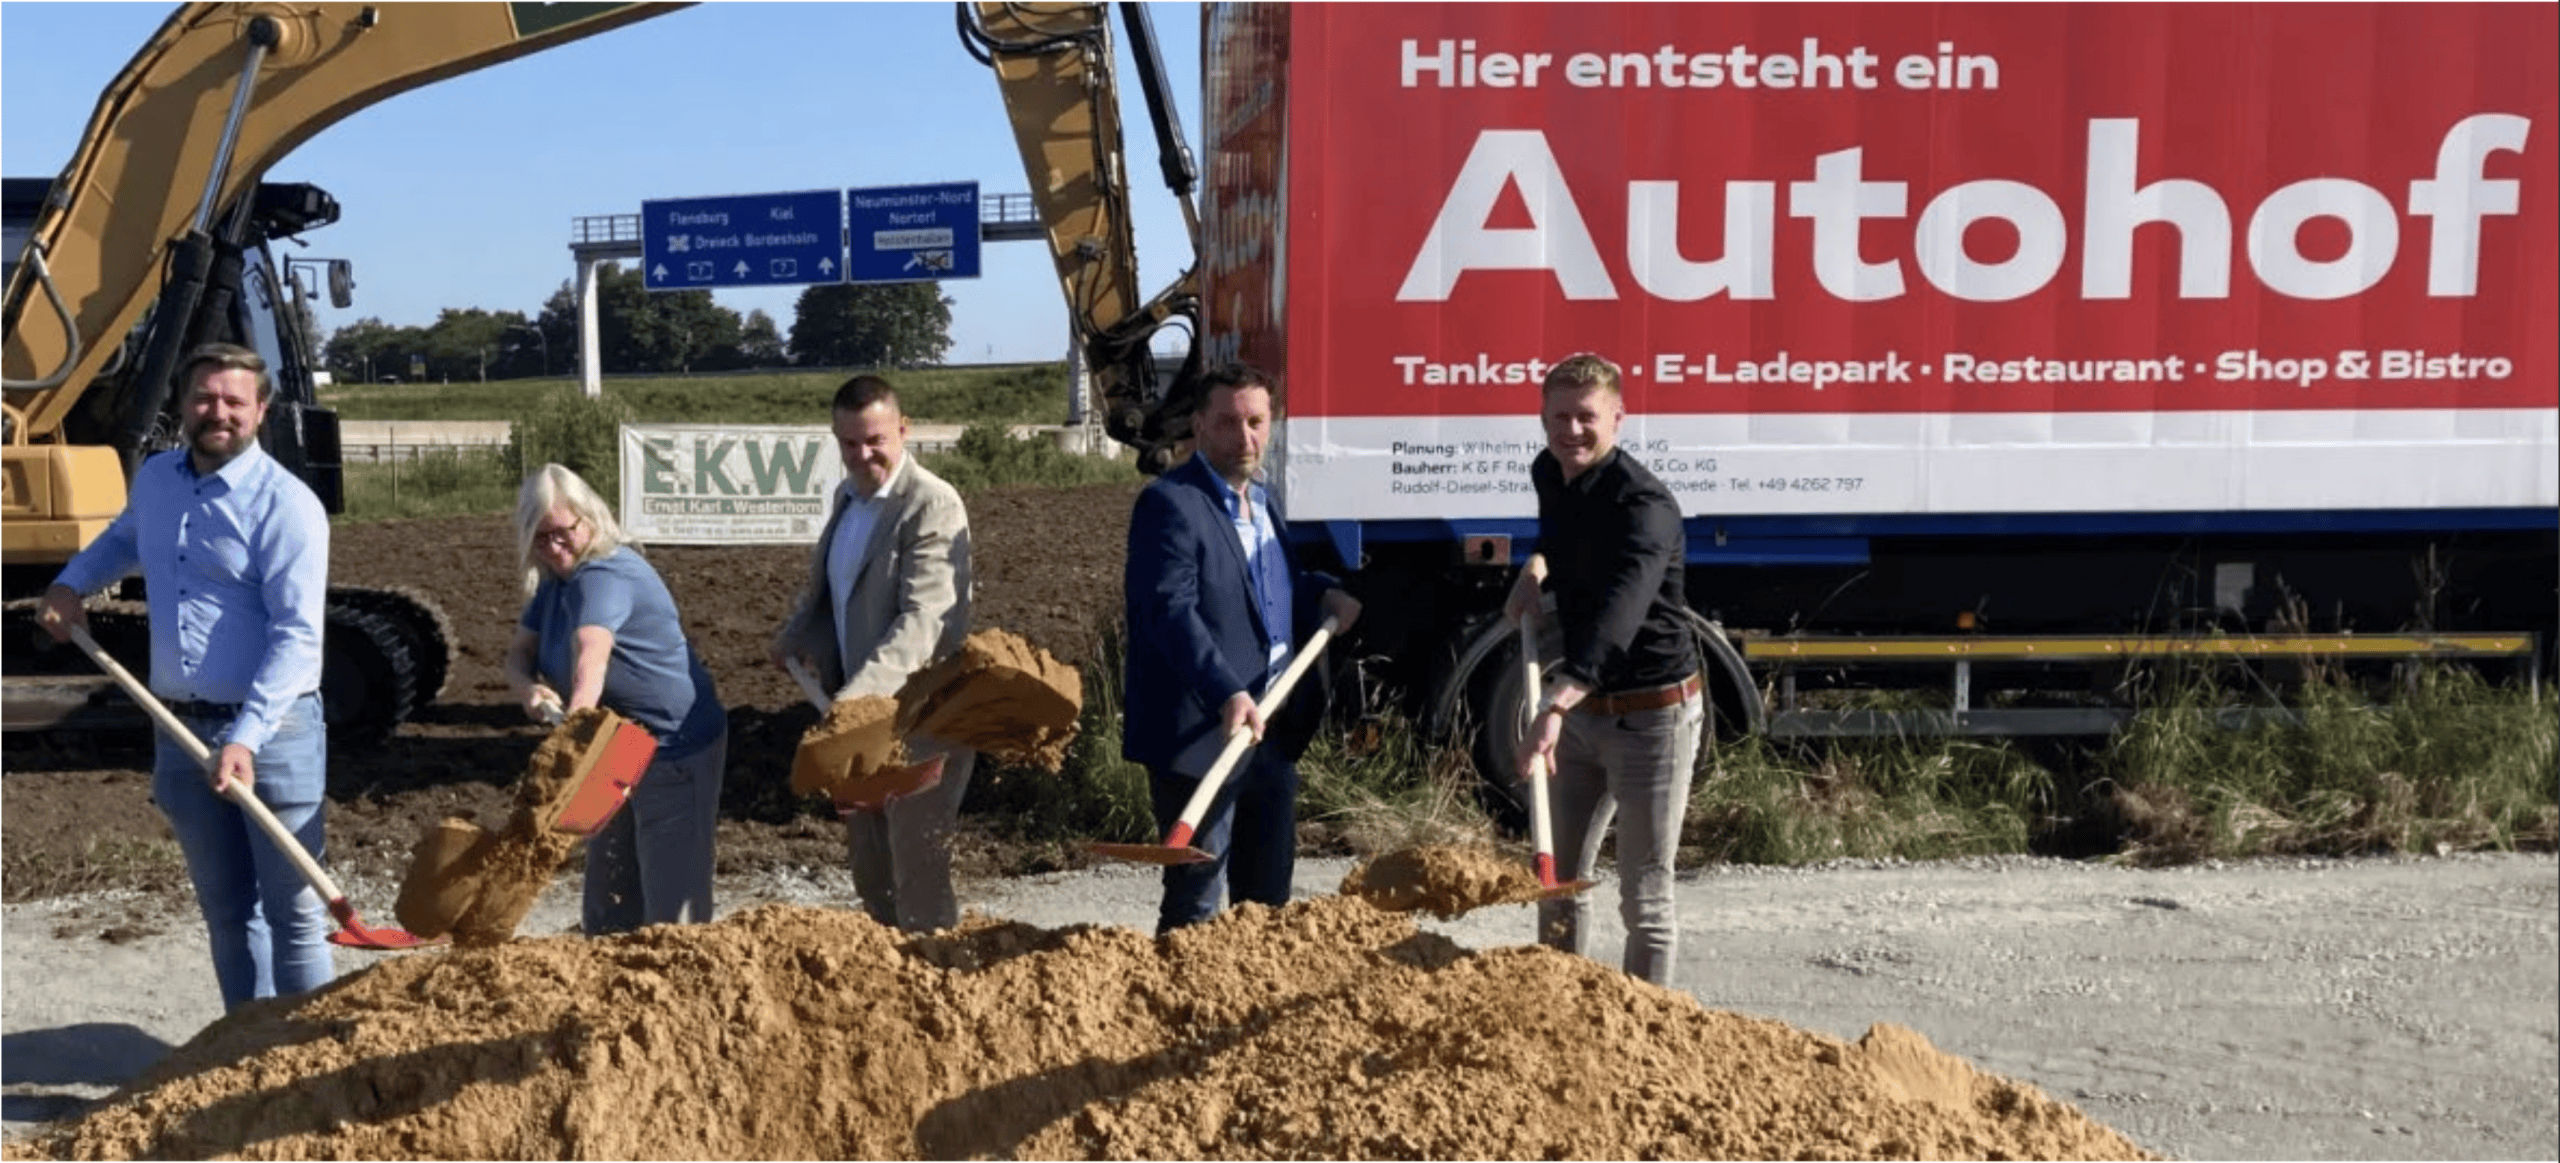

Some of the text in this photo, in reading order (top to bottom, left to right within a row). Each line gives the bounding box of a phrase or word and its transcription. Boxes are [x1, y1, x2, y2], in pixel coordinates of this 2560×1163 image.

[1401, 38, 1999, 90] Hier entsteht ein
[855, 190, 971, 208] Neumünster-Nord
[1395, 112, 2531, 303] Autohof
[669, 206, 795, 226] Flensburg Kiel
[695, 234, 740, 249] Dreieck
[1393, 350, 2512, 391] Tankst E-Ladepark Restaurant Shop & Bistro
[1392, 441, 1458, 458] Planung:
[1462, 440, 1521, 455] Wilhelm
[1647, 439, 1669, 453] KG
[643, 438, 823, 495] E.K.W.
[1392, 461, 1457, 475] Bauherr:
[1462, 461, 1474, 475] K
[1477, 460, 1489, 474] &
[1492, 460, 1502, 474] F
[1653, 459, 1664, 472] &
[1695, 458, 1717, 472] KG
[1759, 478, 1787, 491] +49
[1790, 478, 1831, 491] 4262
[1835, 478, 1864, 491] 797
